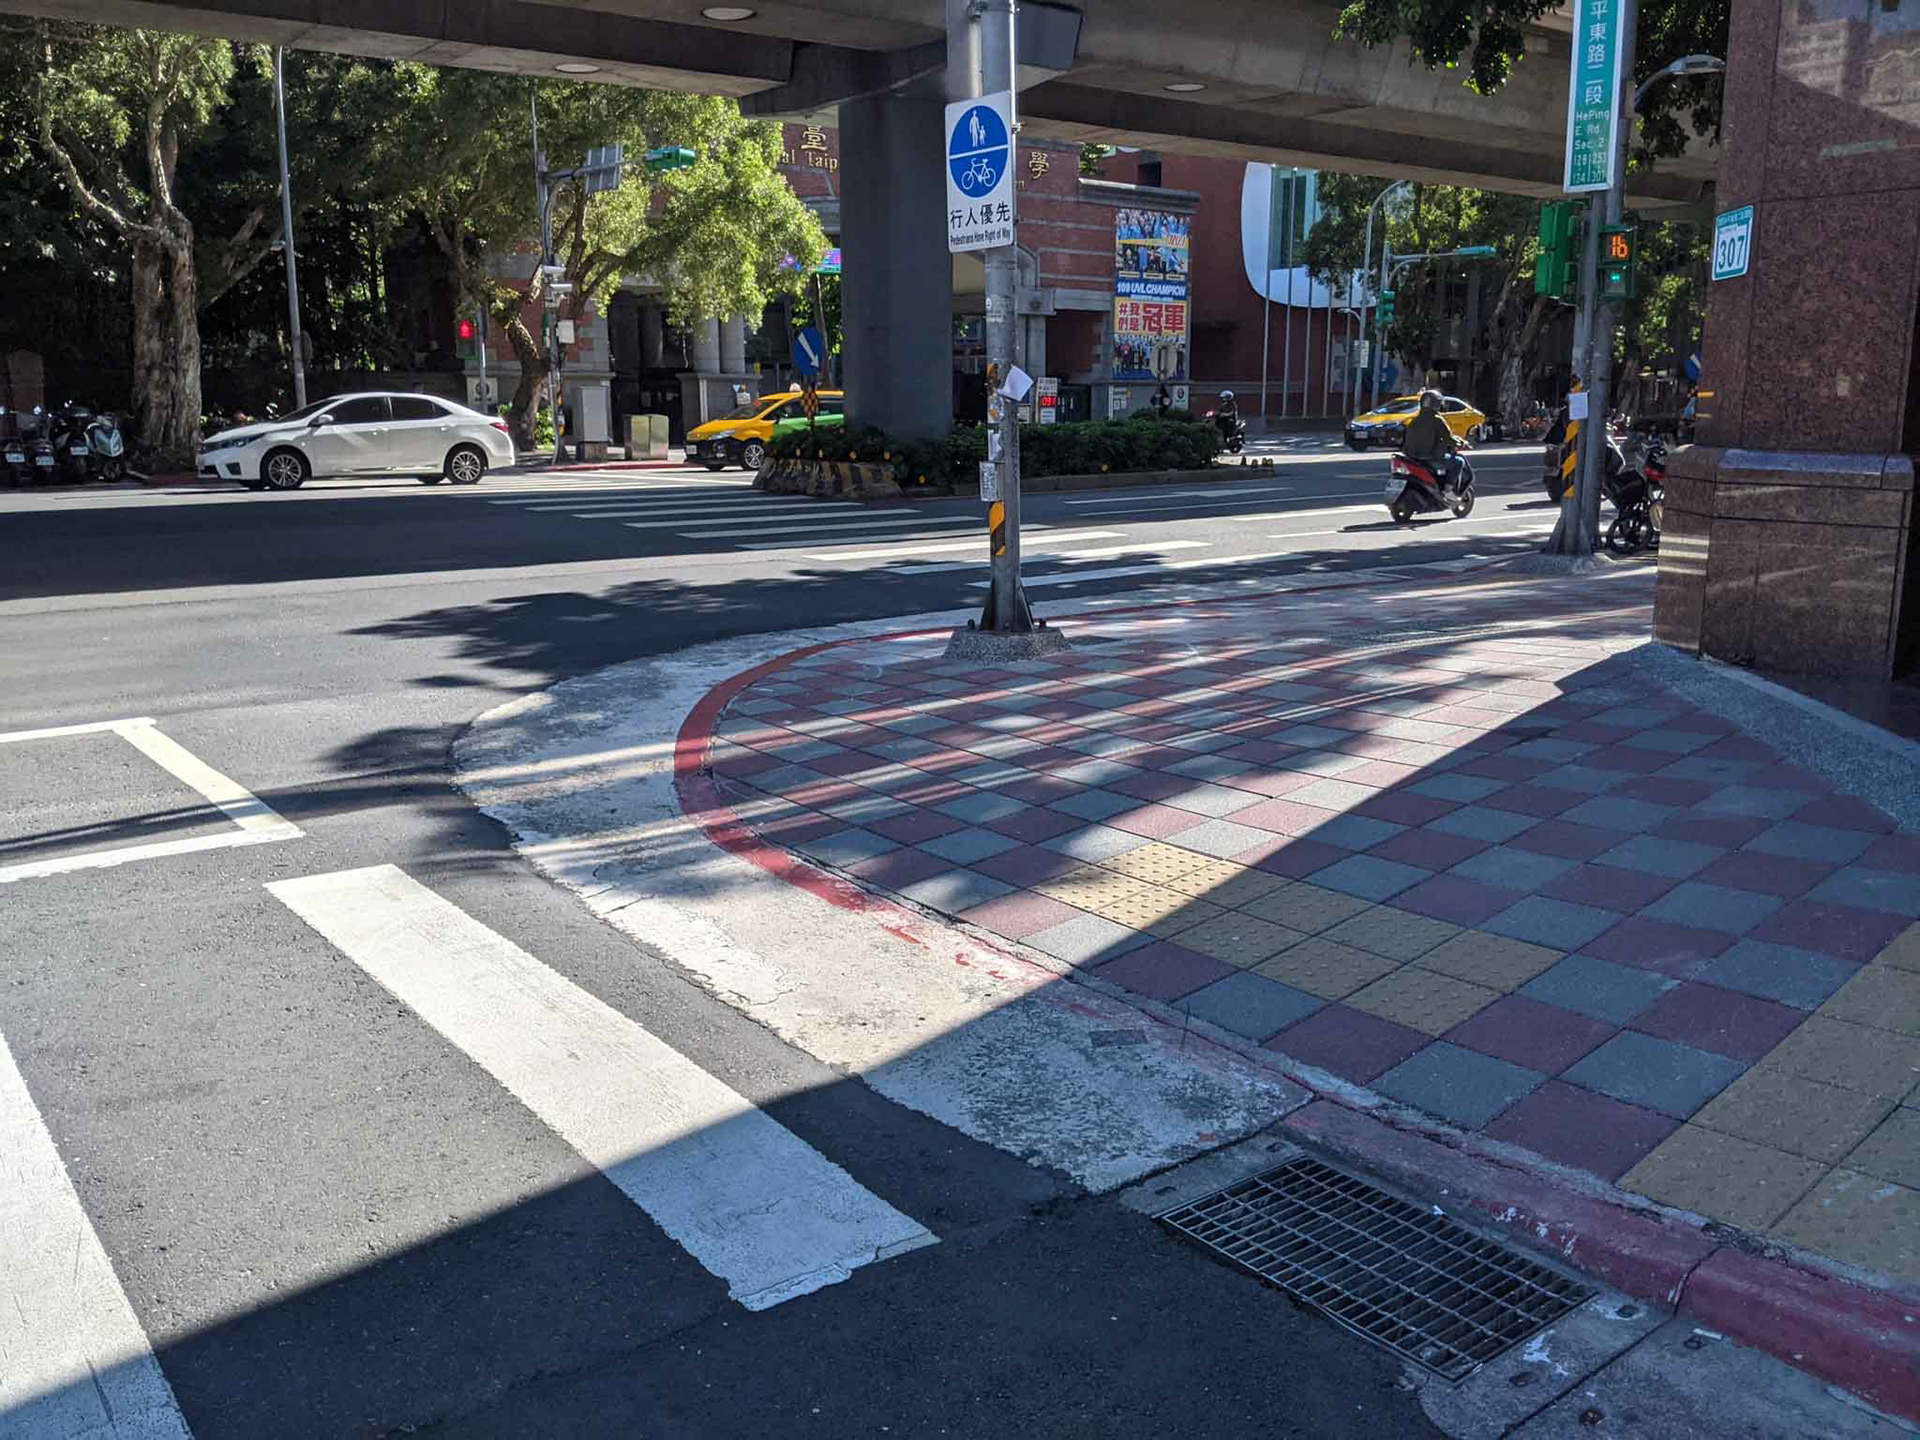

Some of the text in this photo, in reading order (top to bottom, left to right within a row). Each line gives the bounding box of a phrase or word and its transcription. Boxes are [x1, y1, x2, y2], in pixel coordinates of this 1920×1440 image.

[805, 151, 838, 173] Taip
[950, 201, 1010, 229] 行人優先
[1612, 235, 1628, 259] 16
[1718, 235, 1745, 270] 307
[1145, 284, 1186, 297] CHAMPION
[1143, 303, 1185, 333] 冠軍
